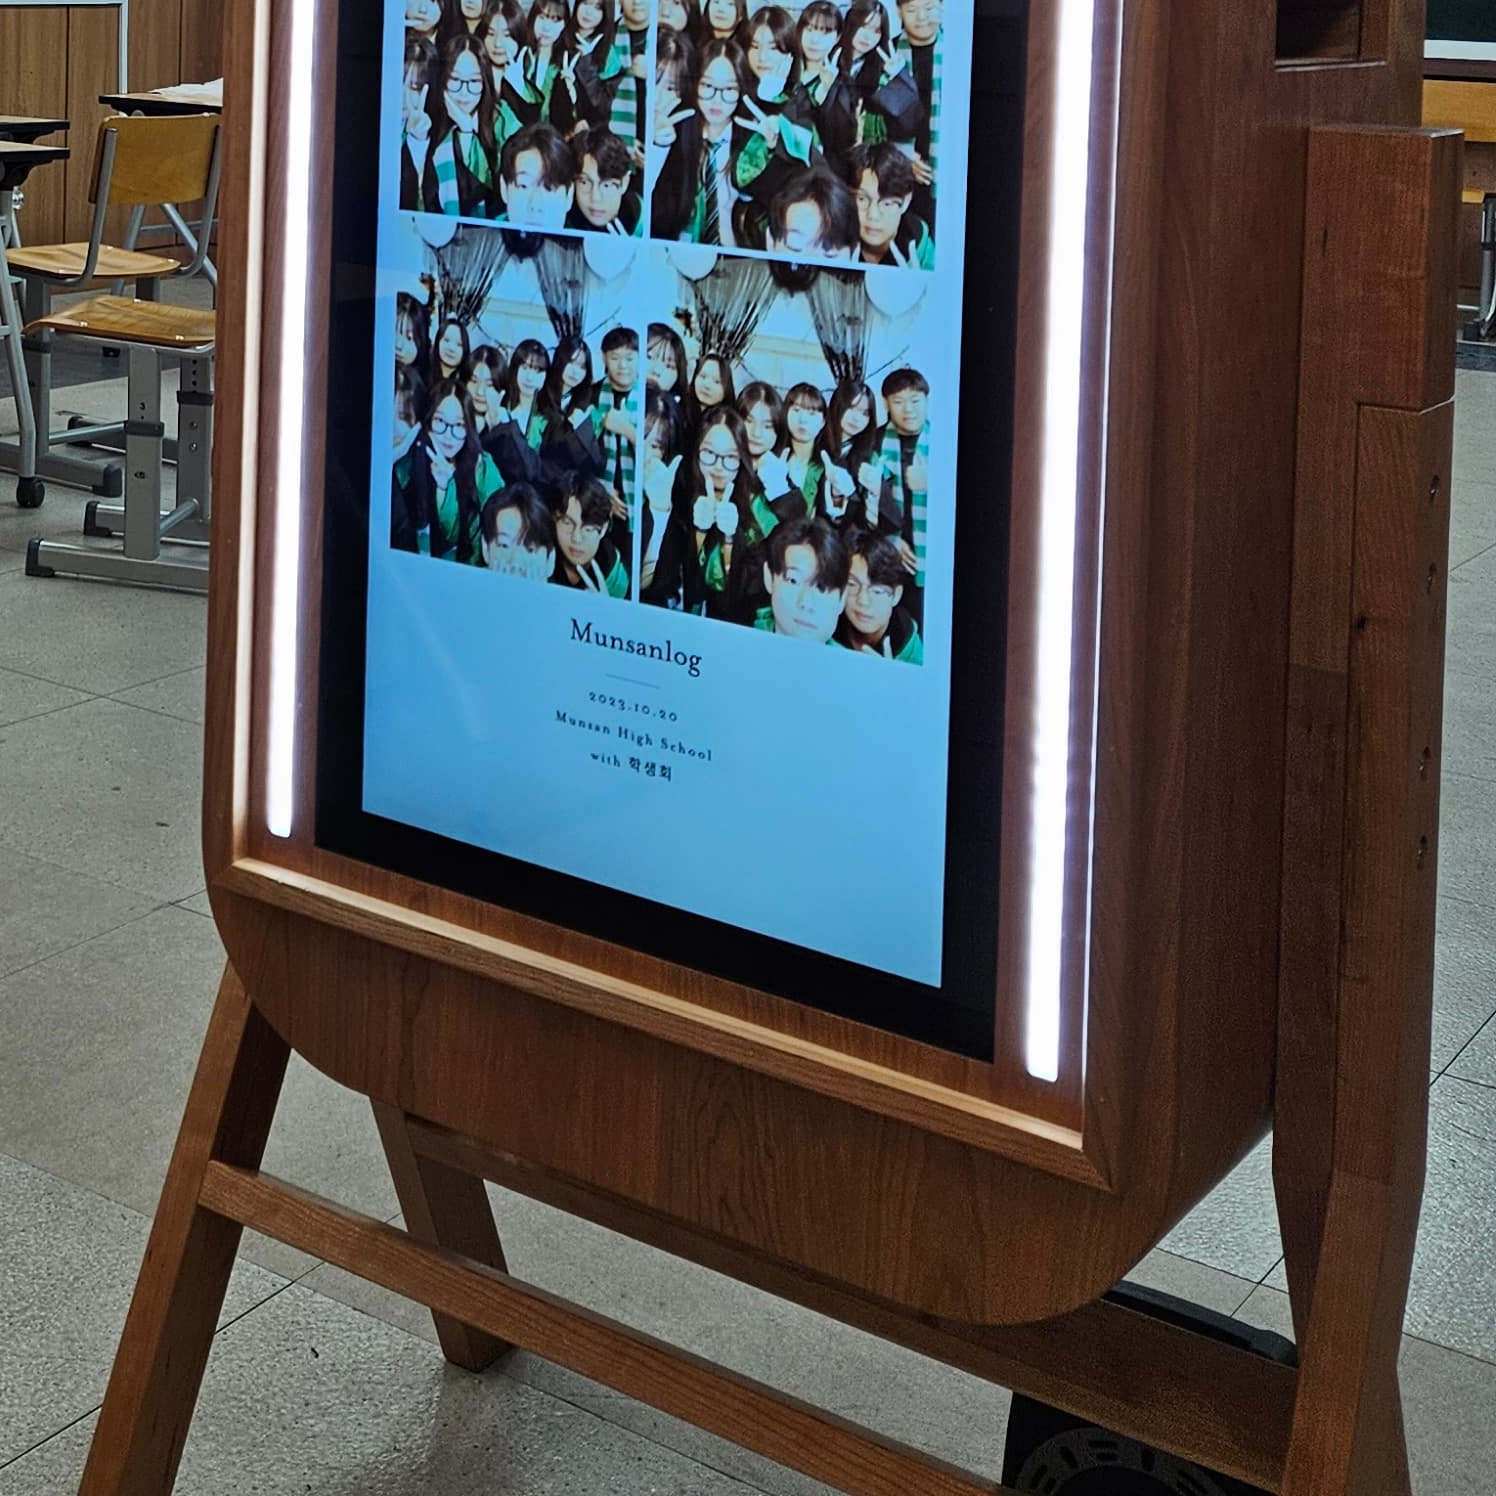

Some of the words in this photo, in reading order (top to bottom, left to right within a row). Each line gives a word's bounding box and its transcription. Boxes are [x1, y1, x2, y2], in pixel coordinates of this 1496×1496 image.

[570, 618, 703, 678] Munsanlog
[588, 691, 678, 722] 2023.10.20
[555, 710, 610, 735] Munsan
[618, 726, 653, 747] High
[660, 737, 712, 761] School
[590, 753, 621, 768] with
